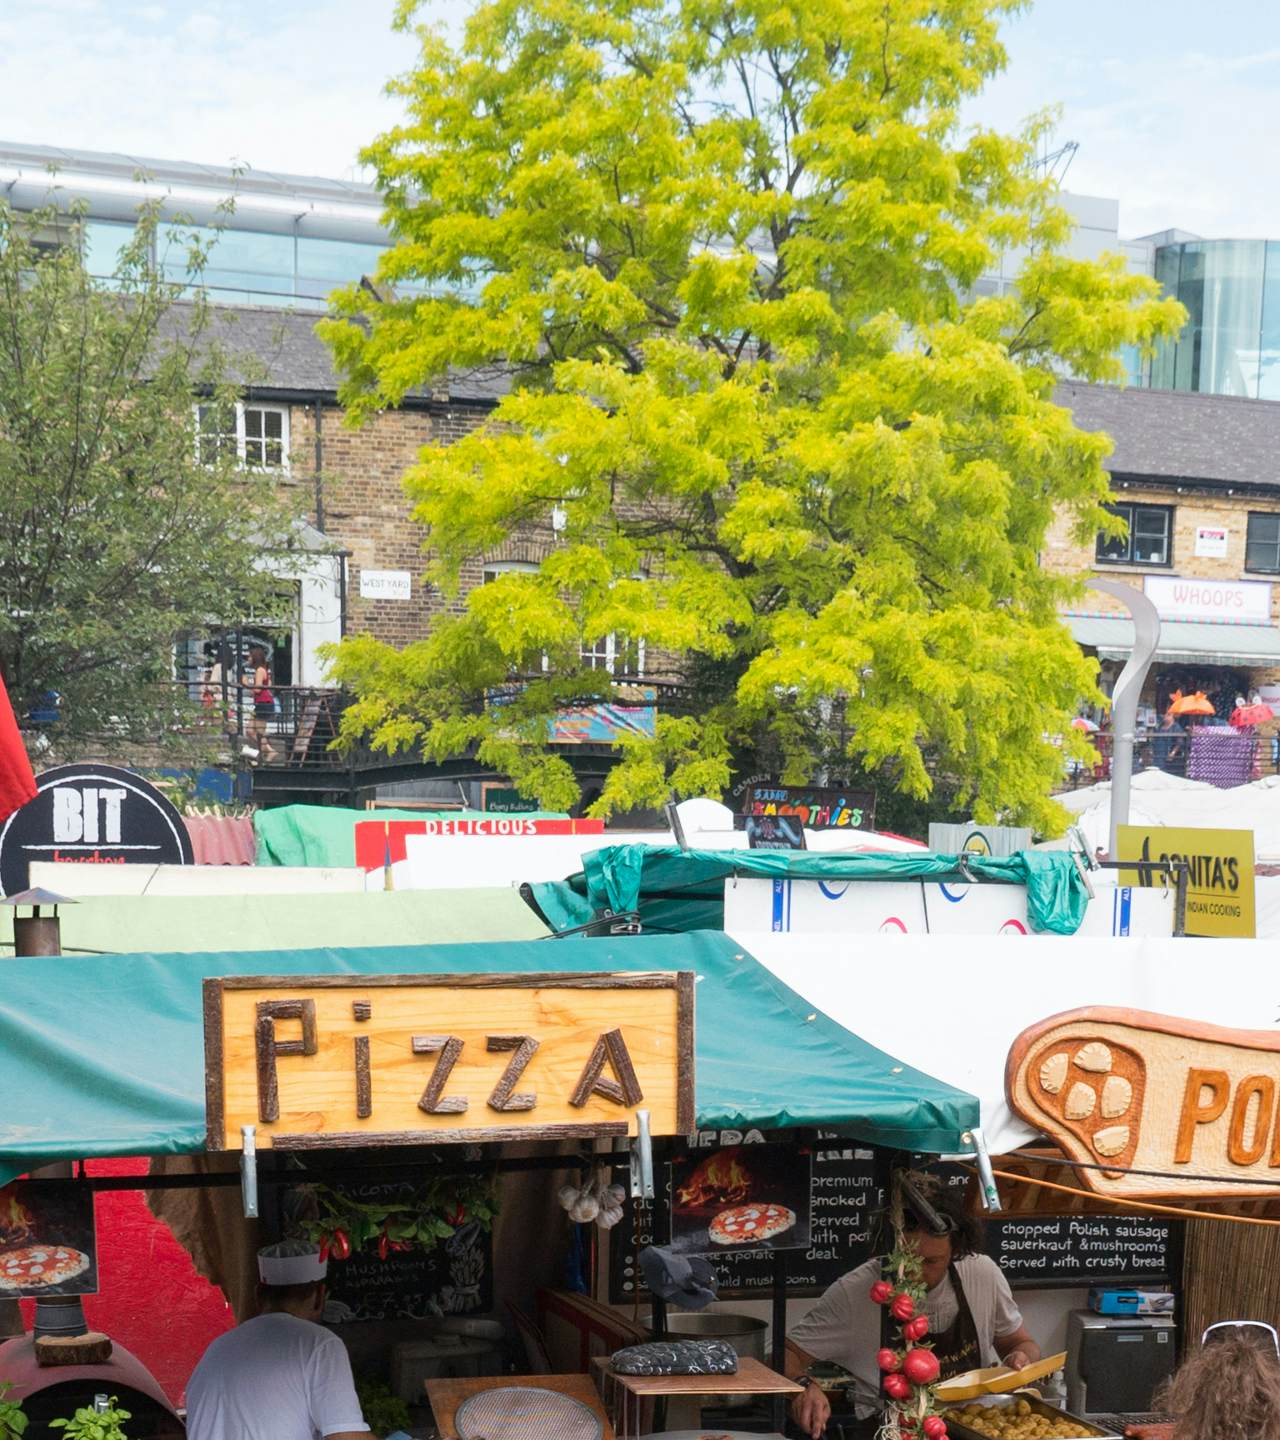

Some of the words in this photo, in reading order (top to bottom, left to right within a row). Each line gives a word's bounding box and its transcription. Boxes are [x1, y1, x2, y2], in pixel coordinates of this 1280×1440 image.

[1173, 585, 1244, 608] WHOOPS
[53, 787, 127, 843] BIT
[426, 820, 537, 834] DELICIOUS
[1160, 853, 1239, 892] SONITA'S
[1210, 904, 1241, 917] COOKING
[811, 1176, 872, 1187] premium
[1002, 1222, 1060, 1236] chopped
[1069, 1222, 1109, 1236] Polish
[1115, 1225, 1169, 1242] sausage
[1000, 1237, 1072, 1250] sauerkraut
[999, 1255, 1047, 1269] Served
[1052, 1254, 1080, 1268] with
[1085, 1255, 1127, 1271] crusty
